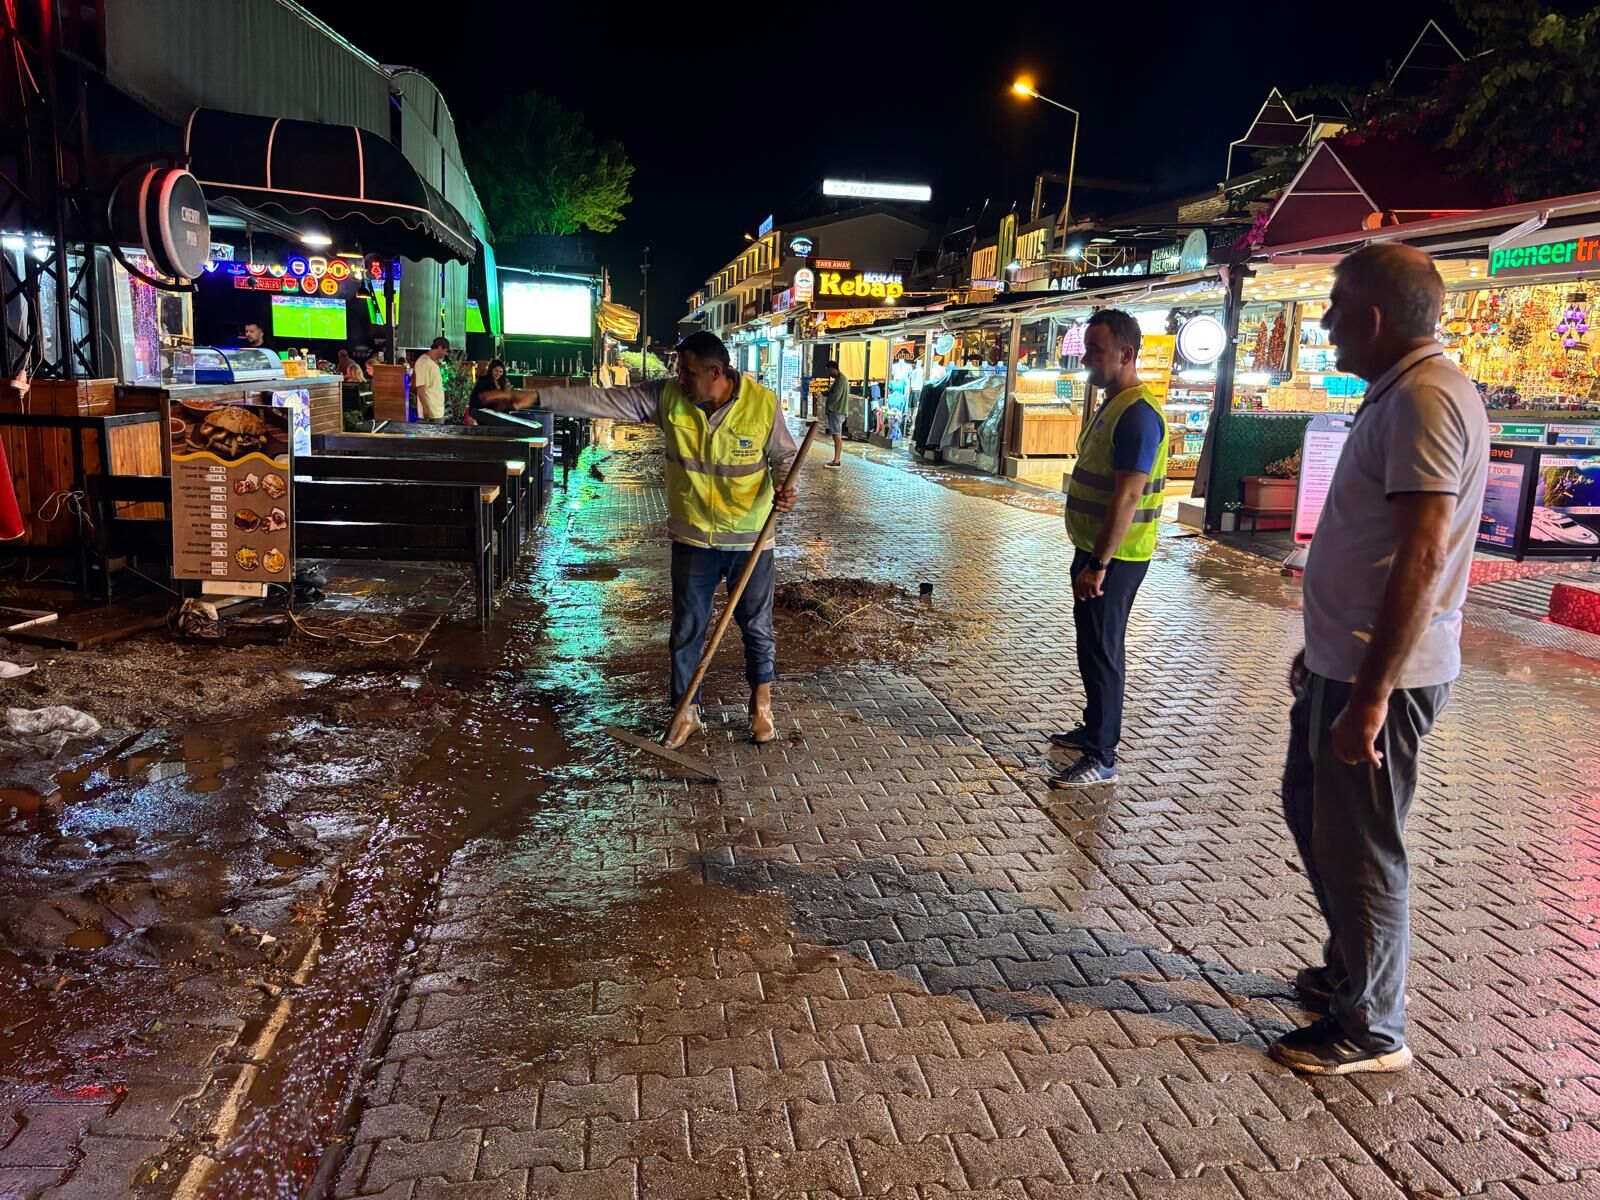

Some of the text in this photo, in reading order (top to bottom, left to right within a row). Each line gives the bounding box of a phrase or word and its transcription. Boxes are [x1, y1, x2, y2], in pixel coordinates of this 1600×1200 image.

[182, 206, 200, 224] CHERRY
[187, 230, 198, 247] PUB
[1152, 244, 1180, 262] TURKISH
[833, 261, 850, 269] AWAY
[864, 273, 902, 285] KONAK
[1493, 466, 1511, 475] TOUR
